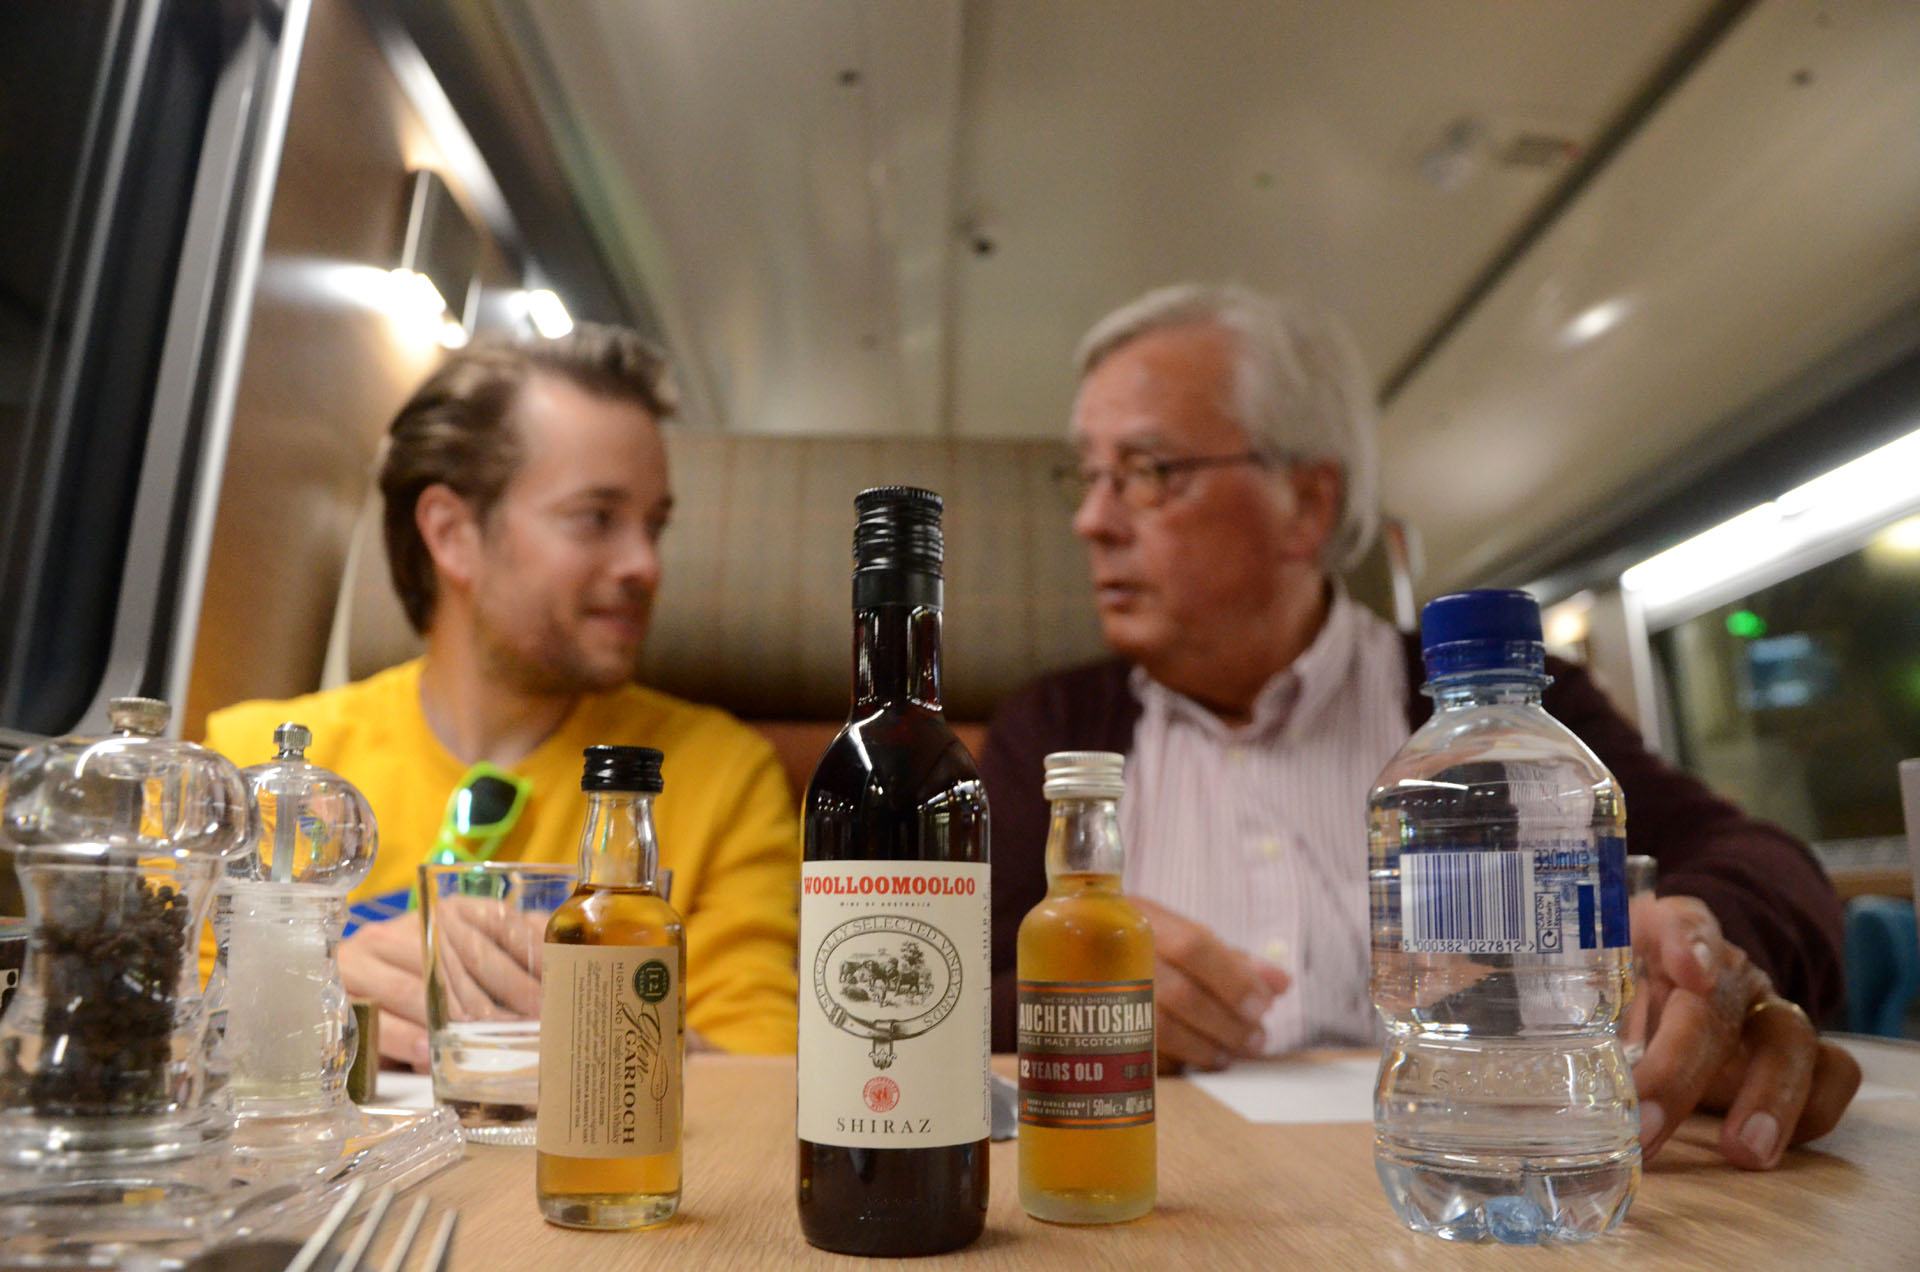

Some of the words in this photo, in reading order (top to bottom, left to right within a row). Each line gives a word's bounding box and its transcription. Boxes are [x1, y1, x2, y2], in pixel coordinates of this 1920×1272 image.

[803, 875, 976, 897] WOOLLOOMOOLOO
[1403, 940, 1410, 952] 5
[1416, 940, 1464, 953] 000382
[1468, 940, 1522, 953] 027812
[815, 924, 852, 1010] SPECIALLY
[852, 916, 939, 942] SELECTED
[923, 936, 962, 1028] VINEYARDS
[614, 961, 625, 1025] HIGHLAND
[1018, 1002, 1153, 1033] AUCHENTOSHAN
[622, 1003, 664, 1084] Glen
[1044, 1037, 1069, 1047] MALT
[1075, 1037, 1121, 1048] SCOTCH
[1031, 1061, 1070, 1081] YEARS
[1074, 1062, 1104, 1082] OLD
[612, 1082, 622, 1112] Scotch
[622, 1029, 638, 1145] GARIOCH
[611, 1112, 622, 1146] Whisky
[835, 1116, 933, 1136] SHIRAZ
